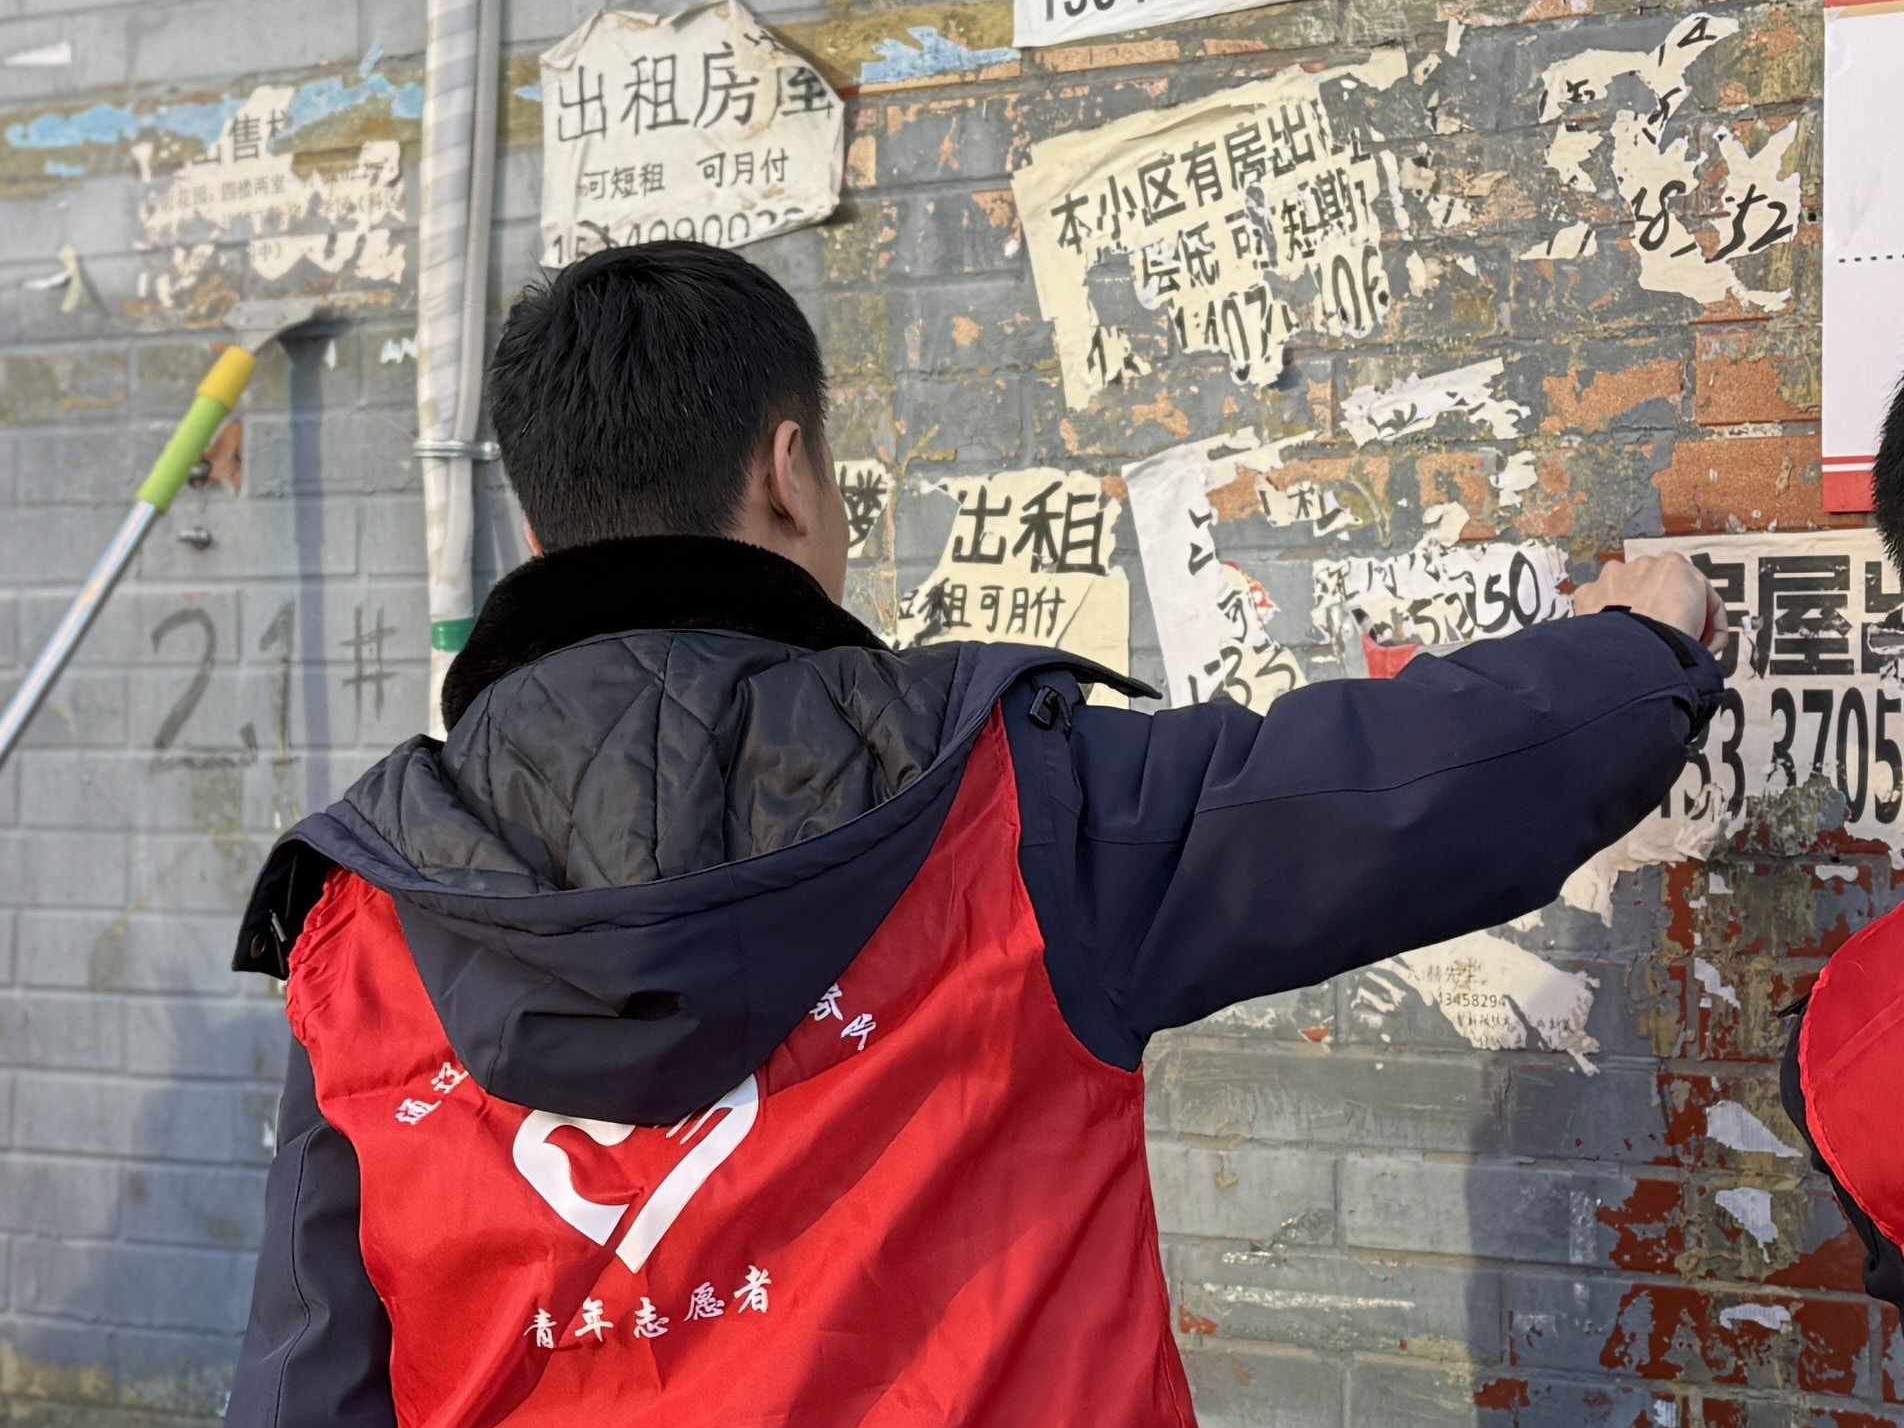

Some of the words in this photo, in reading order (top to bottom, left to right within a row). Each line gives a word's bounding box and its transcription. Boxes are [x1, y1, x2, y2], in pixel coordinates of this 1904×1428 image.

[558, 41, 835, 142] 出租房屋
[583, 163, 667, 200] 可短租
[697, 148, 789, 188] 可月付
[953, 480, 1105, 575] 出租
[524, 1265, 772, 1350] 青年志愿者
